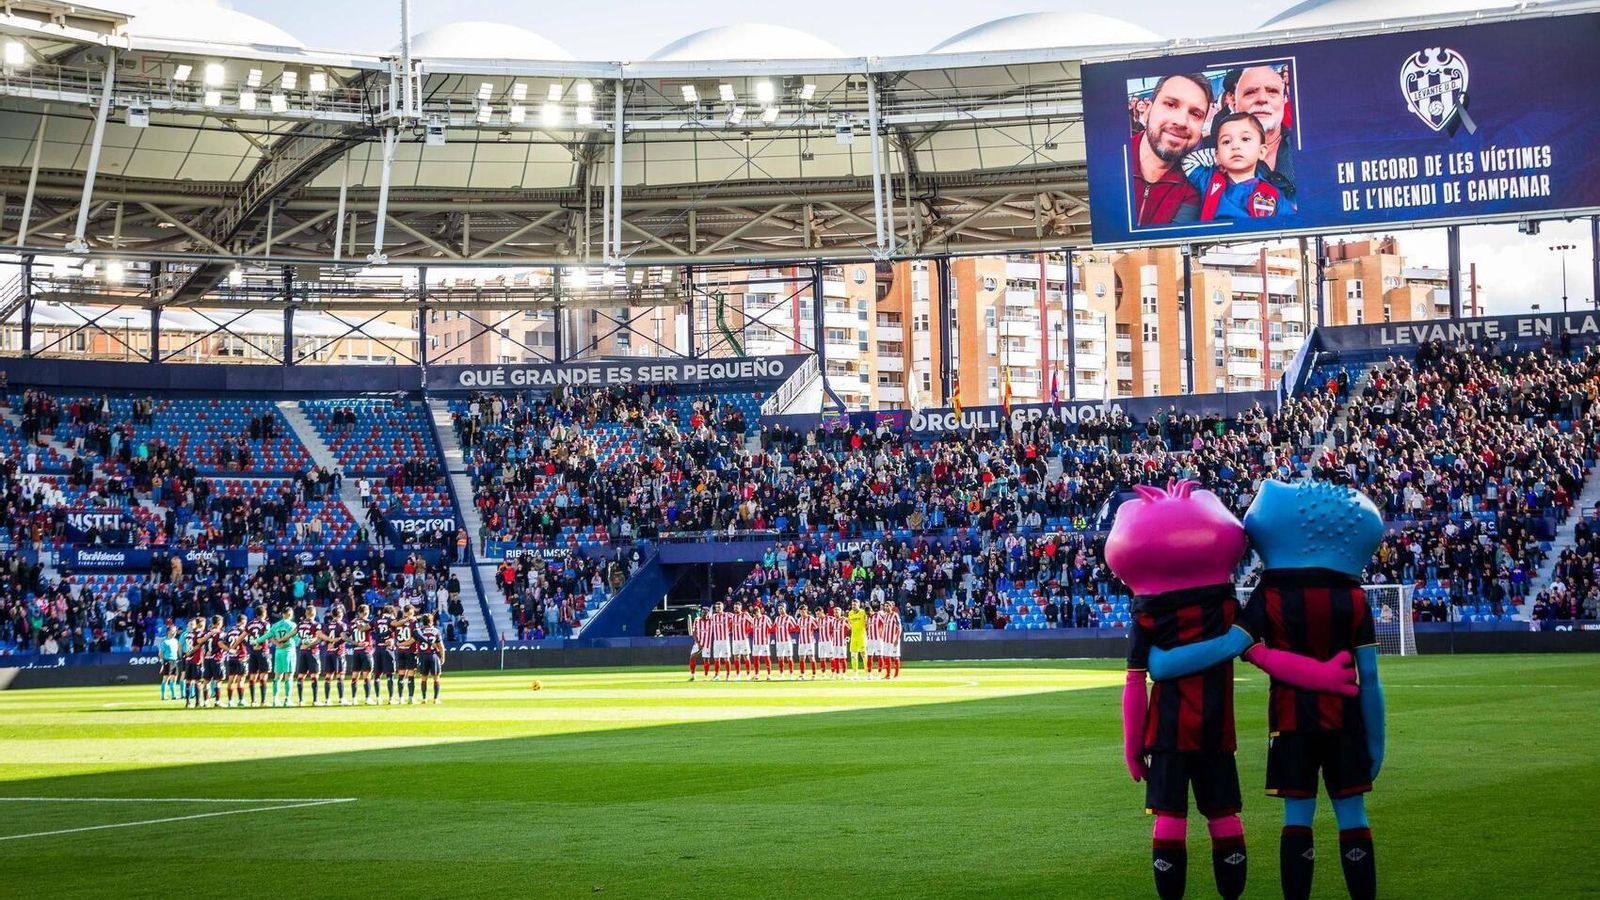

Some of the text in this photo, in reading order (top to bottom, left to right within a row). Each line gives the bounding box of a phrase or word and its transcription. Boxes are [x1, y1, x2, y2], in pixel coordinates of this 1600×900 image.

[1414, 85, 1442, 100] LEVANTE
[1337, 145, 1552, 184] EN RECORD DE LES VÍCTIMES
[1342, 174, 1551, 212] DE L'INCENDI DE CAMPANAR
[1380, 315, 1599, 345] LEVANTE, EN LA
[459, 357, 784, 386] QUÉ GRANDE ES SER PEQUEÑO
[389, 518, 455, 532] macron
[506, 549, 541, 558] RIBRA
[396, 626, 411, 641] 30
